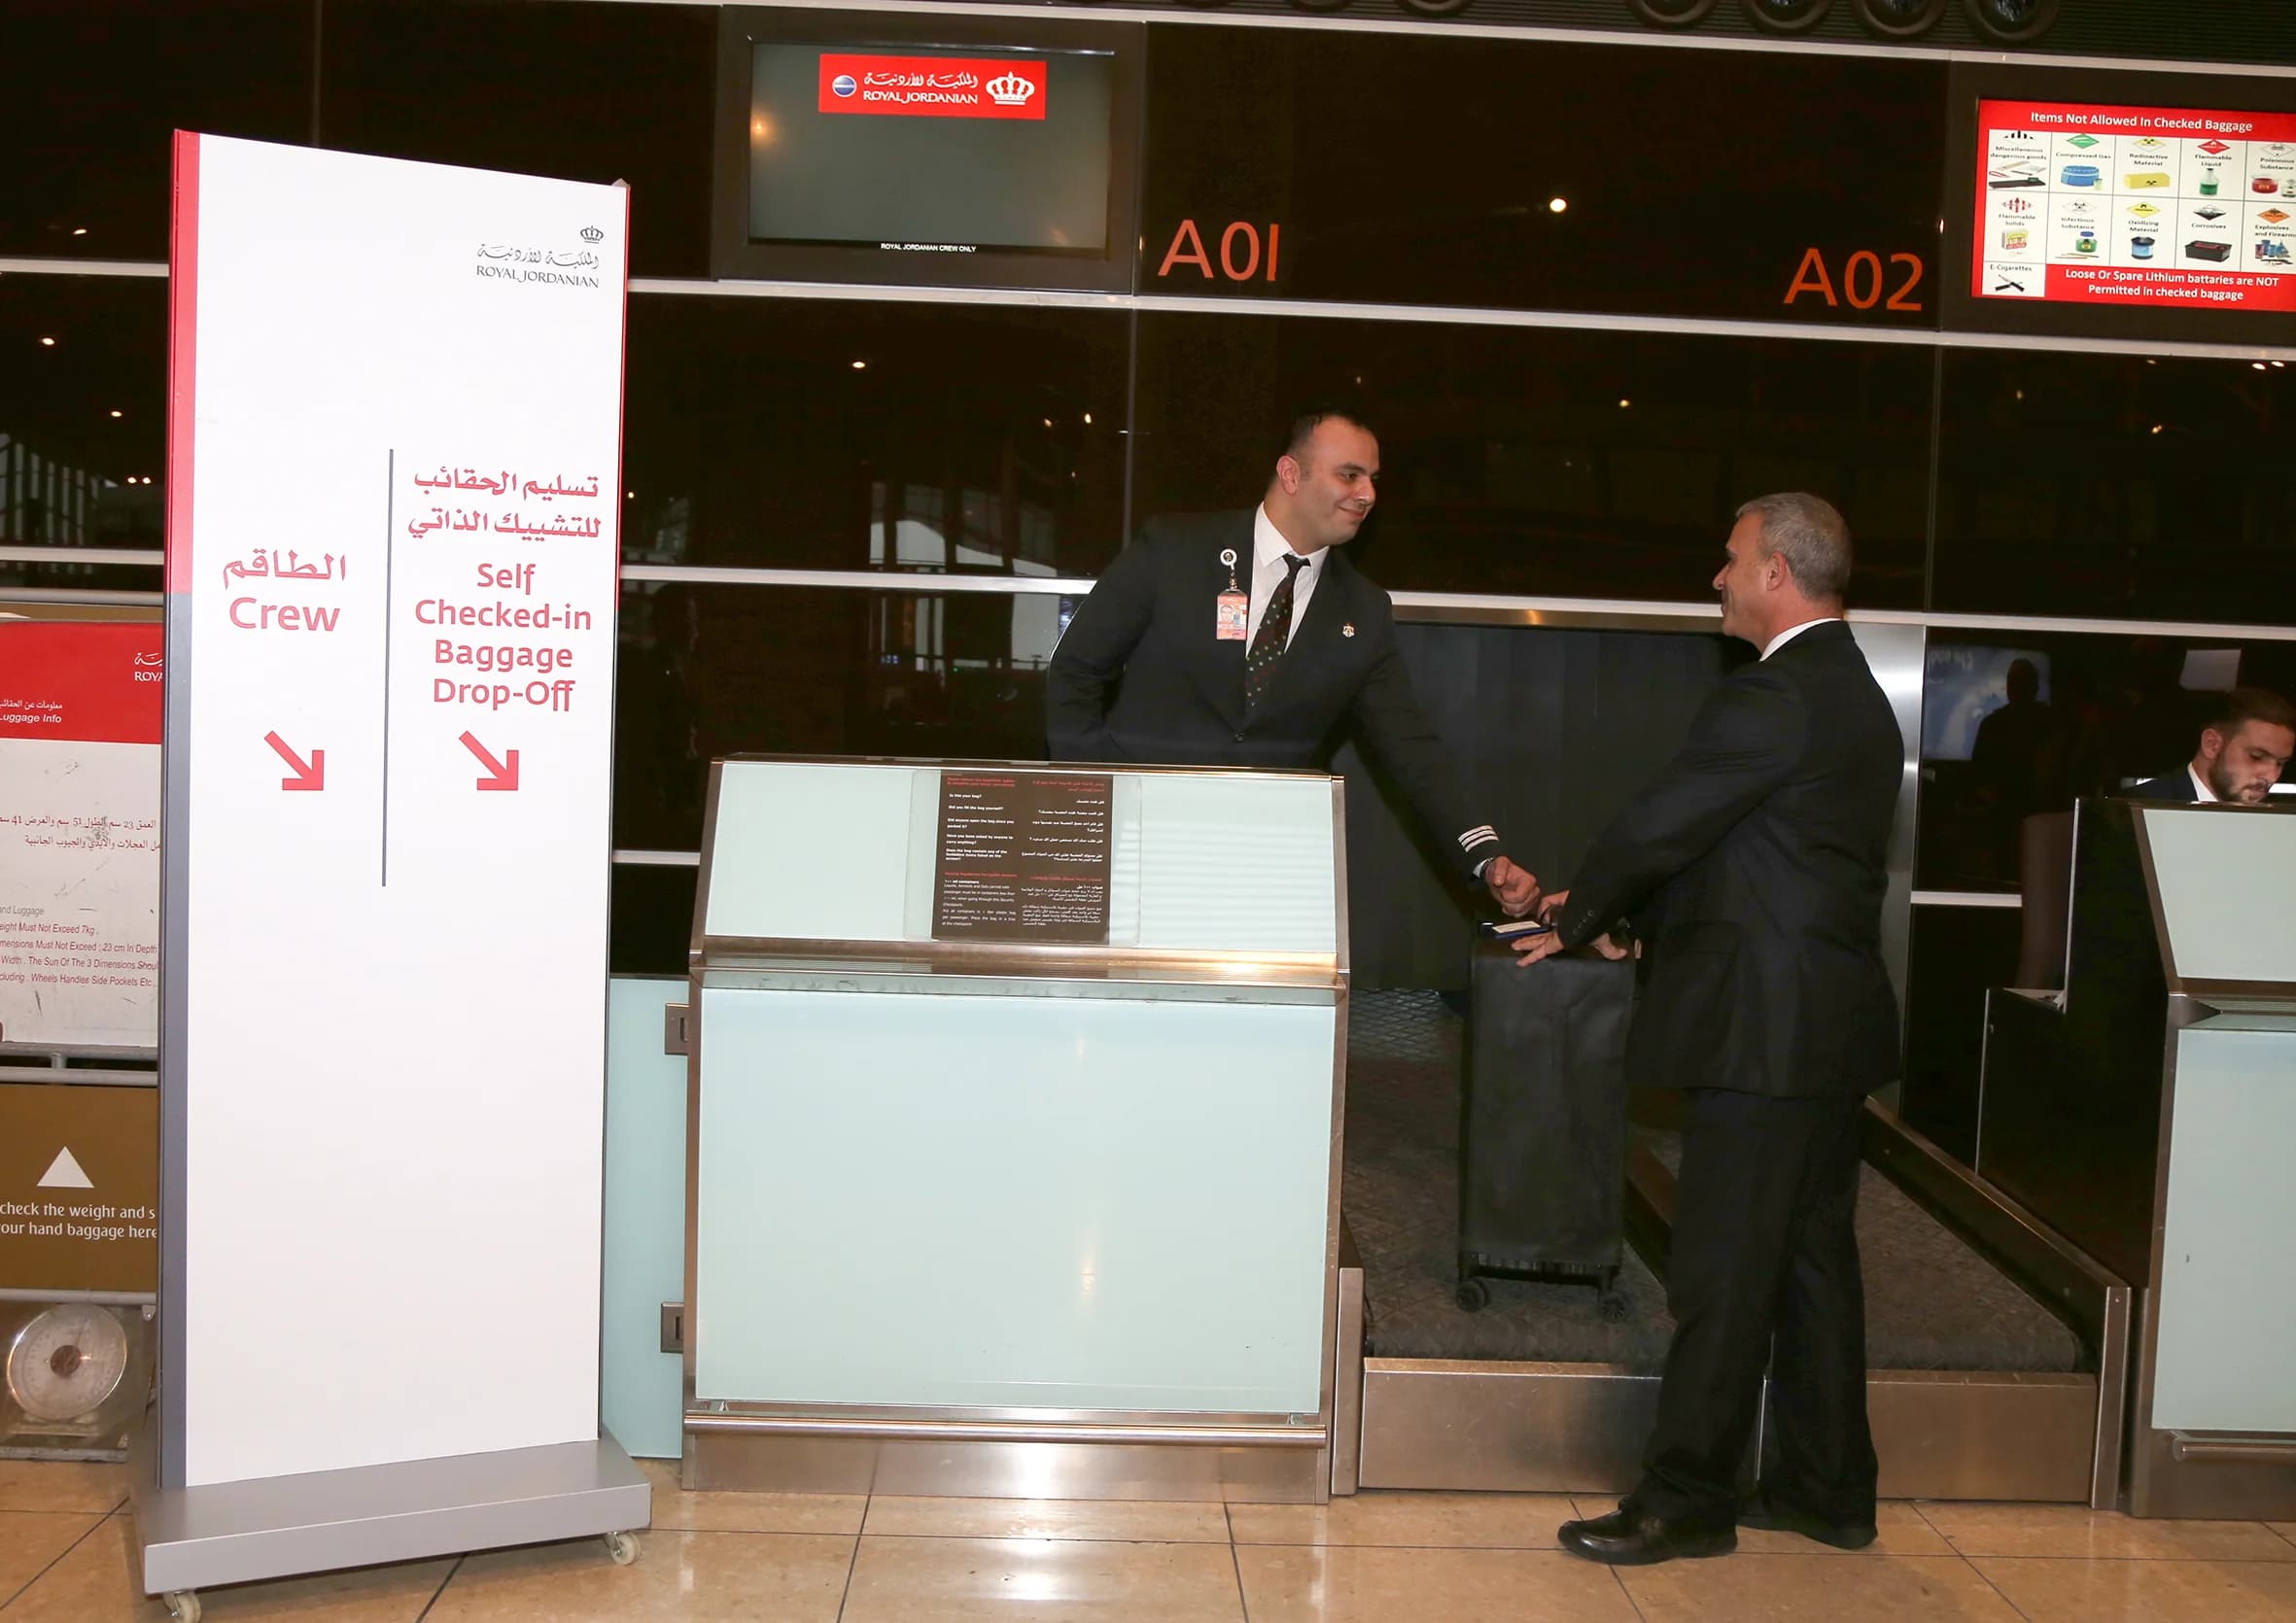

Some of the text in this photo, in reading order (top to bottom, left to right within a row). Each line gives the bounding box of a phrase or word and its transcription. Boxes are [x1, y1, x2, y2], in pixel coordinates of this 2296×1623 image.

[863, 90, 978, 104] ROYAL JORDANIAN
[2031, 112, 2253, 133] Items Not Allowed In Checked Baggage
[2129, 226, 2159, 235] Material
[2191, 223, 2227, 231] Corrosives
[2270, 231, 2296, 240] Firearm
[880, 242, 903, 251] ROYAL
[903, 243, 939, 252] JORDANIAN
[958, 245, 977, 254] ONLY
[1158, 219, 1279, 282] A01
[476, 264, 600, 289] ROYAL JORDANIAN
[1784, 248, 1923, 311] A02
[2066, 268, 2279, 290] Loose Or Spare Lithium battaries are NOT
[2088, 284, 2141, 298] Permitted
[2155, 288, 2198, 301] checked
[2201, 290, 2244, 305] baggage
[413, 466, 599, 501] تسليم الحقائب
[408, 508, 489, 541] الذاتي
[223, 549, 347, 591] الطاقم
[477, 563, 537, 596] Self
[229, 597, 340, 632] Crew
[415, 598, 593, 632] Checked-in
[435, 639, 574, 674] Baggage
[24, 701, 36, 710] عن
[434, 678, 575, 712] Drop-Off
[36, 700, 63, 712] معلومات
[43, 714, 62, 723] Info
[13, 905, 46, 917] Luggage
[0, 922, 17, 934] eight
[19, 922, 37, 933] Must
[39, 923, 52, 933] Not
[53, 924, 80, 934] Exceed
[0, 941, 34, 950] mensions
[36, 940, 54, 950] Must
[55, 942, 69, 951] Not
[70, 942, 97, 952] Exceed
[103, 943, 113, 952] 23
[114, 944, 125, 953] cm
[136, 945, 157, 956] Depth
[29, 956, 44, 966] The
[61, 957, 71, 968] Of
[72, 958, 86, 968] The
[87, 959, 92, 968] 3
[93, 959, 136, 971] Dimensions
[31, 973, 58, 984] Wheels
[60, 974, 90, 985] Handles
[91, 975, 108, 986] Side
[109, 976, 138, 986] Pockets
[0, 1201, 40, 1216] check
[44, 1203, 65, 1217] the
[69, 1204, 116, 1222] weight
[120, 1206, 145, 1220] and
[0, 1222, 157, 1241] our hand baggage here
